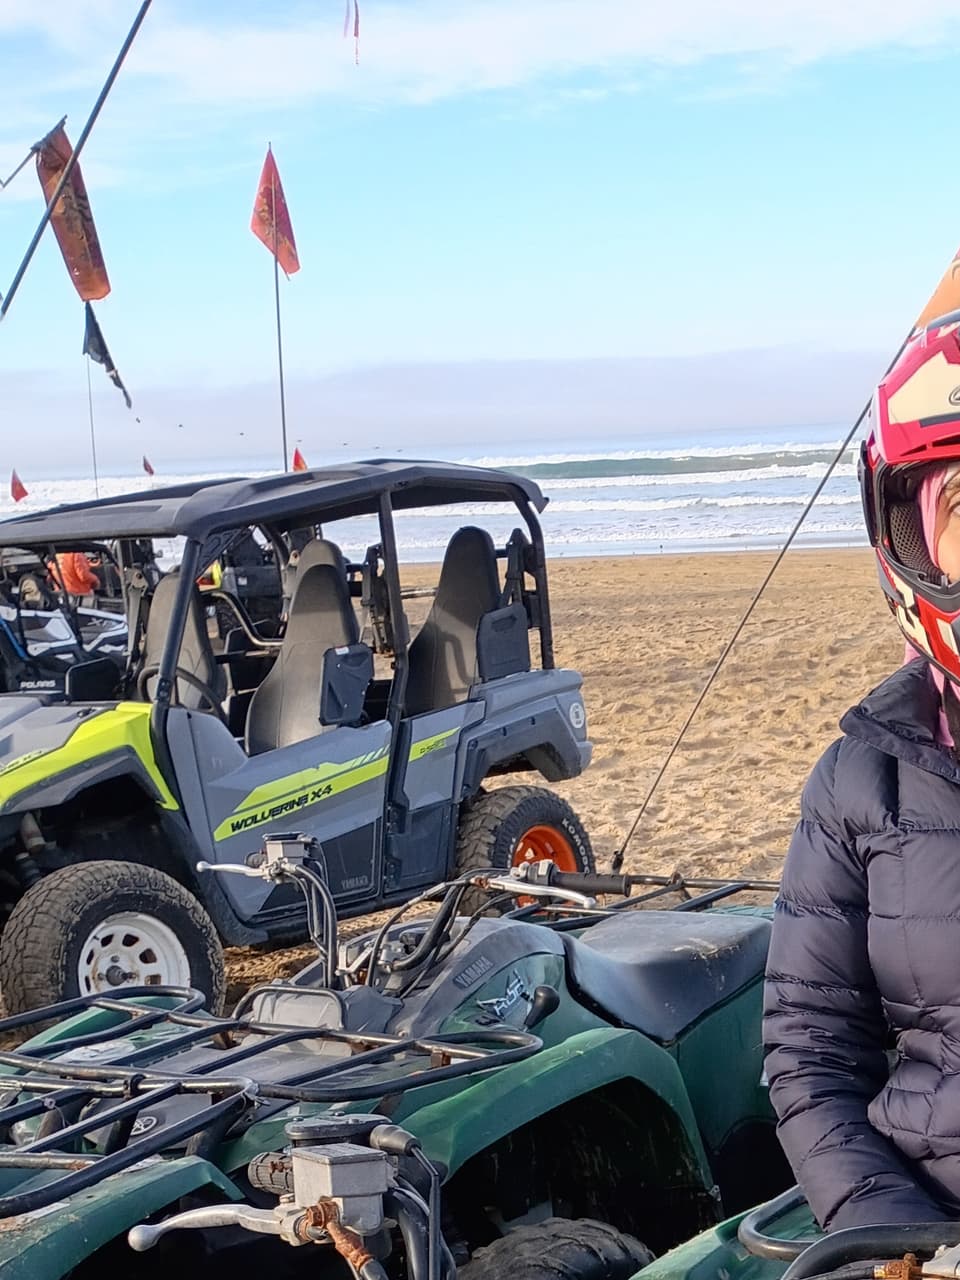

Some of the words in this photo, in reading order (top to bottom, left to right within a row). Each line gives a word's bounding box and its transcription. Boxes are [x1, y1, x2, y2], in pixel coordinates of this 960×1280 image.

[20, 680, 56, 689] POLARIS
[230, 793, 309, 832] WOLVERINE
[310, 784, 333, 802] X4
[456, 956, 494, 988] YAMAHA
